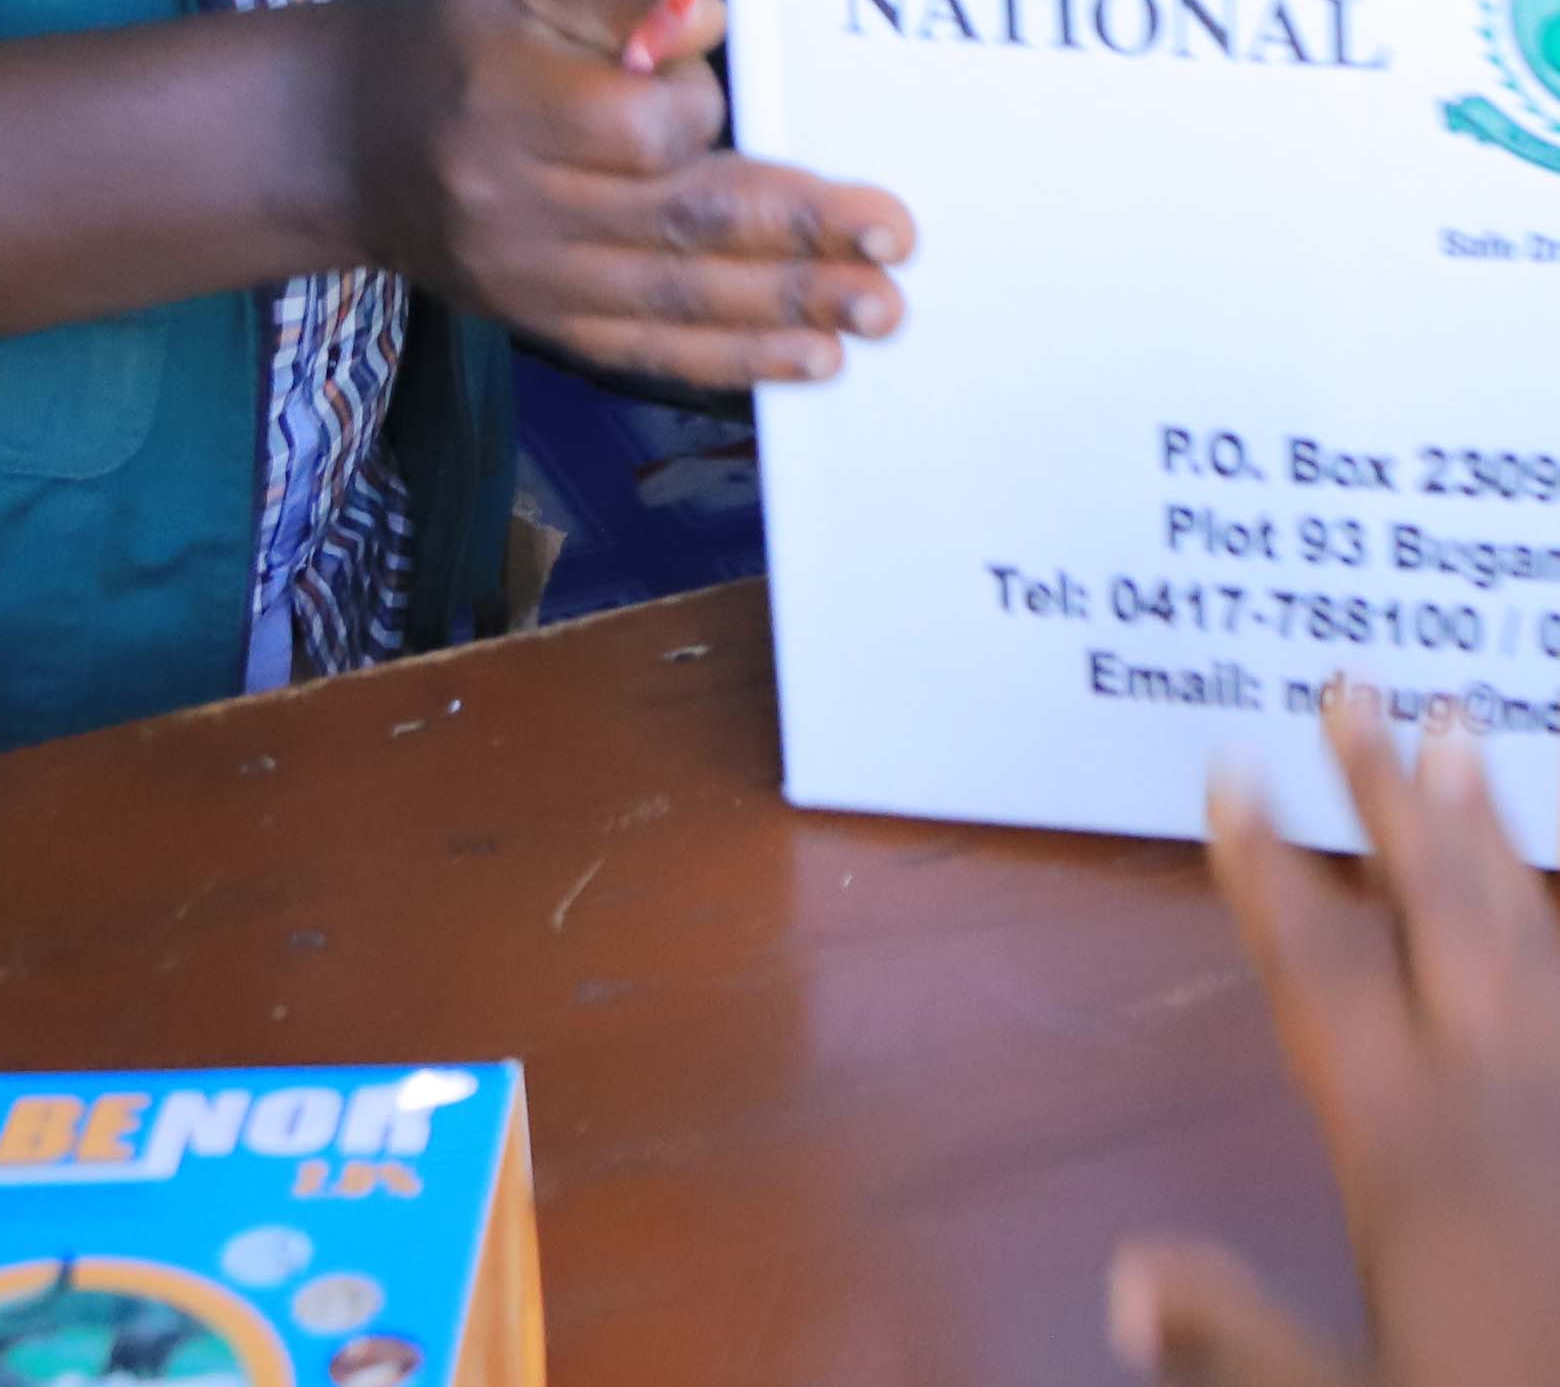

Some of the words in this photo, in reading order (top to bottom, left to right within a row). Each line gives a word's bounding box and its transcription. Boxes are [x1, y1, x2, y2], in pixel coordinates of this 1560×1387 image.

[1158, 425, 1264, 483] P.O.
[1284, 437, 1398, 493] Box
[1165, 503, 1280, 563] Plot
[1299, 515, 1366, 569] 93
[988, 563, 1088, 621] Tel:
[1086, 648, 1266, 713] Email:
